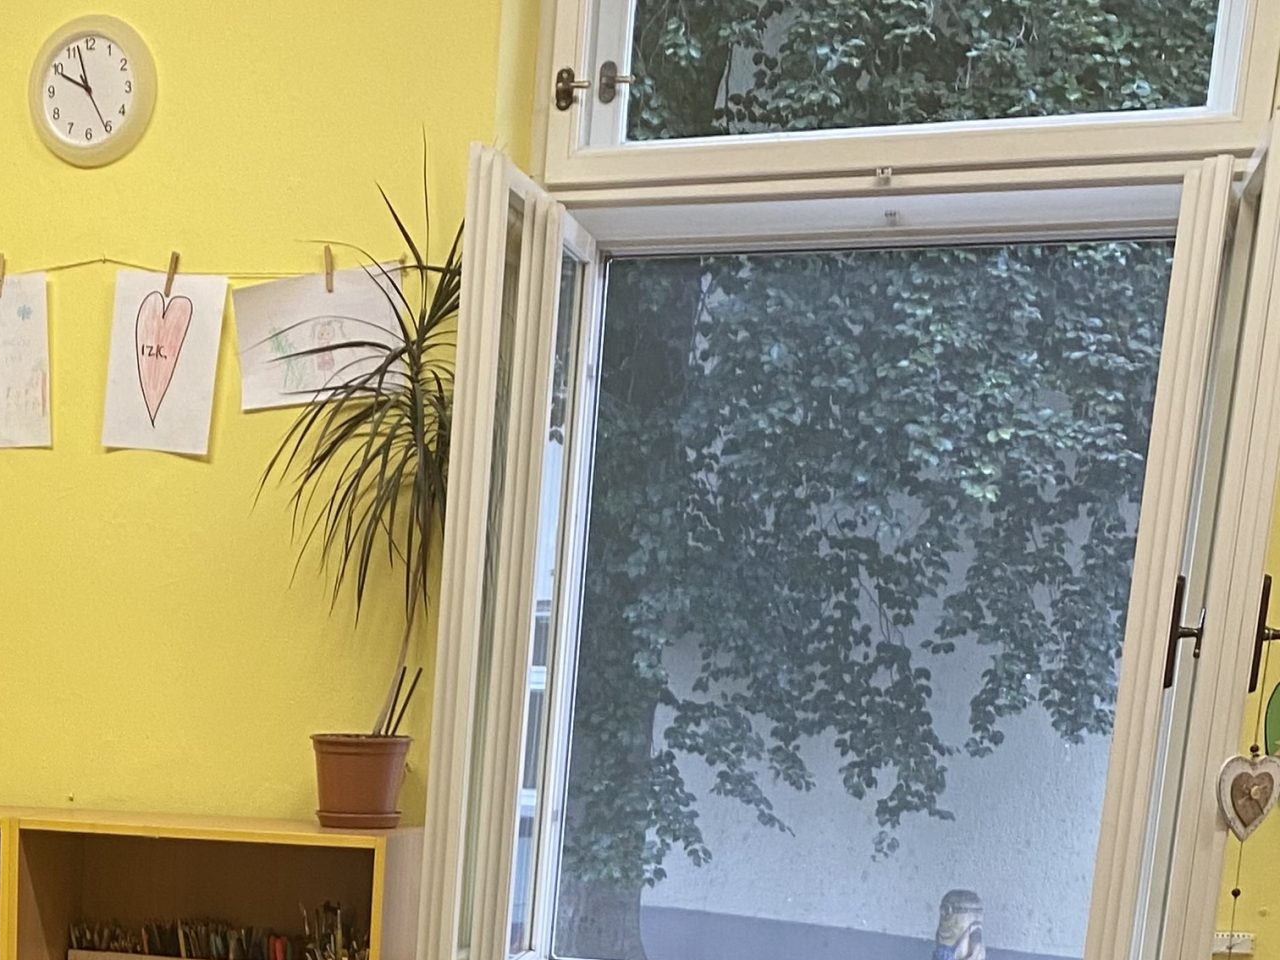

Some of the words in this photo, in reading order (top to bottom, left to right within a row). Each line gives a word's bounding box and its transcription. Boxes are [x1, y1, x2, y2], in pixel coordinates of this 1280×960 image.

[85, 38, 96, 51] 12
[66, 47, 77, 59] 11
[53, 63, 64, 75] 10
[119, 58, 128, 71] 2
[47, 85, 55, 99] 9
[124, 81, 132, 94] 3
[52, 107, 60, 120] 8
[118, 104, 126, 117] 4
[67, 122, 74, 135] 7
[84, 128, 93, 141] 6
